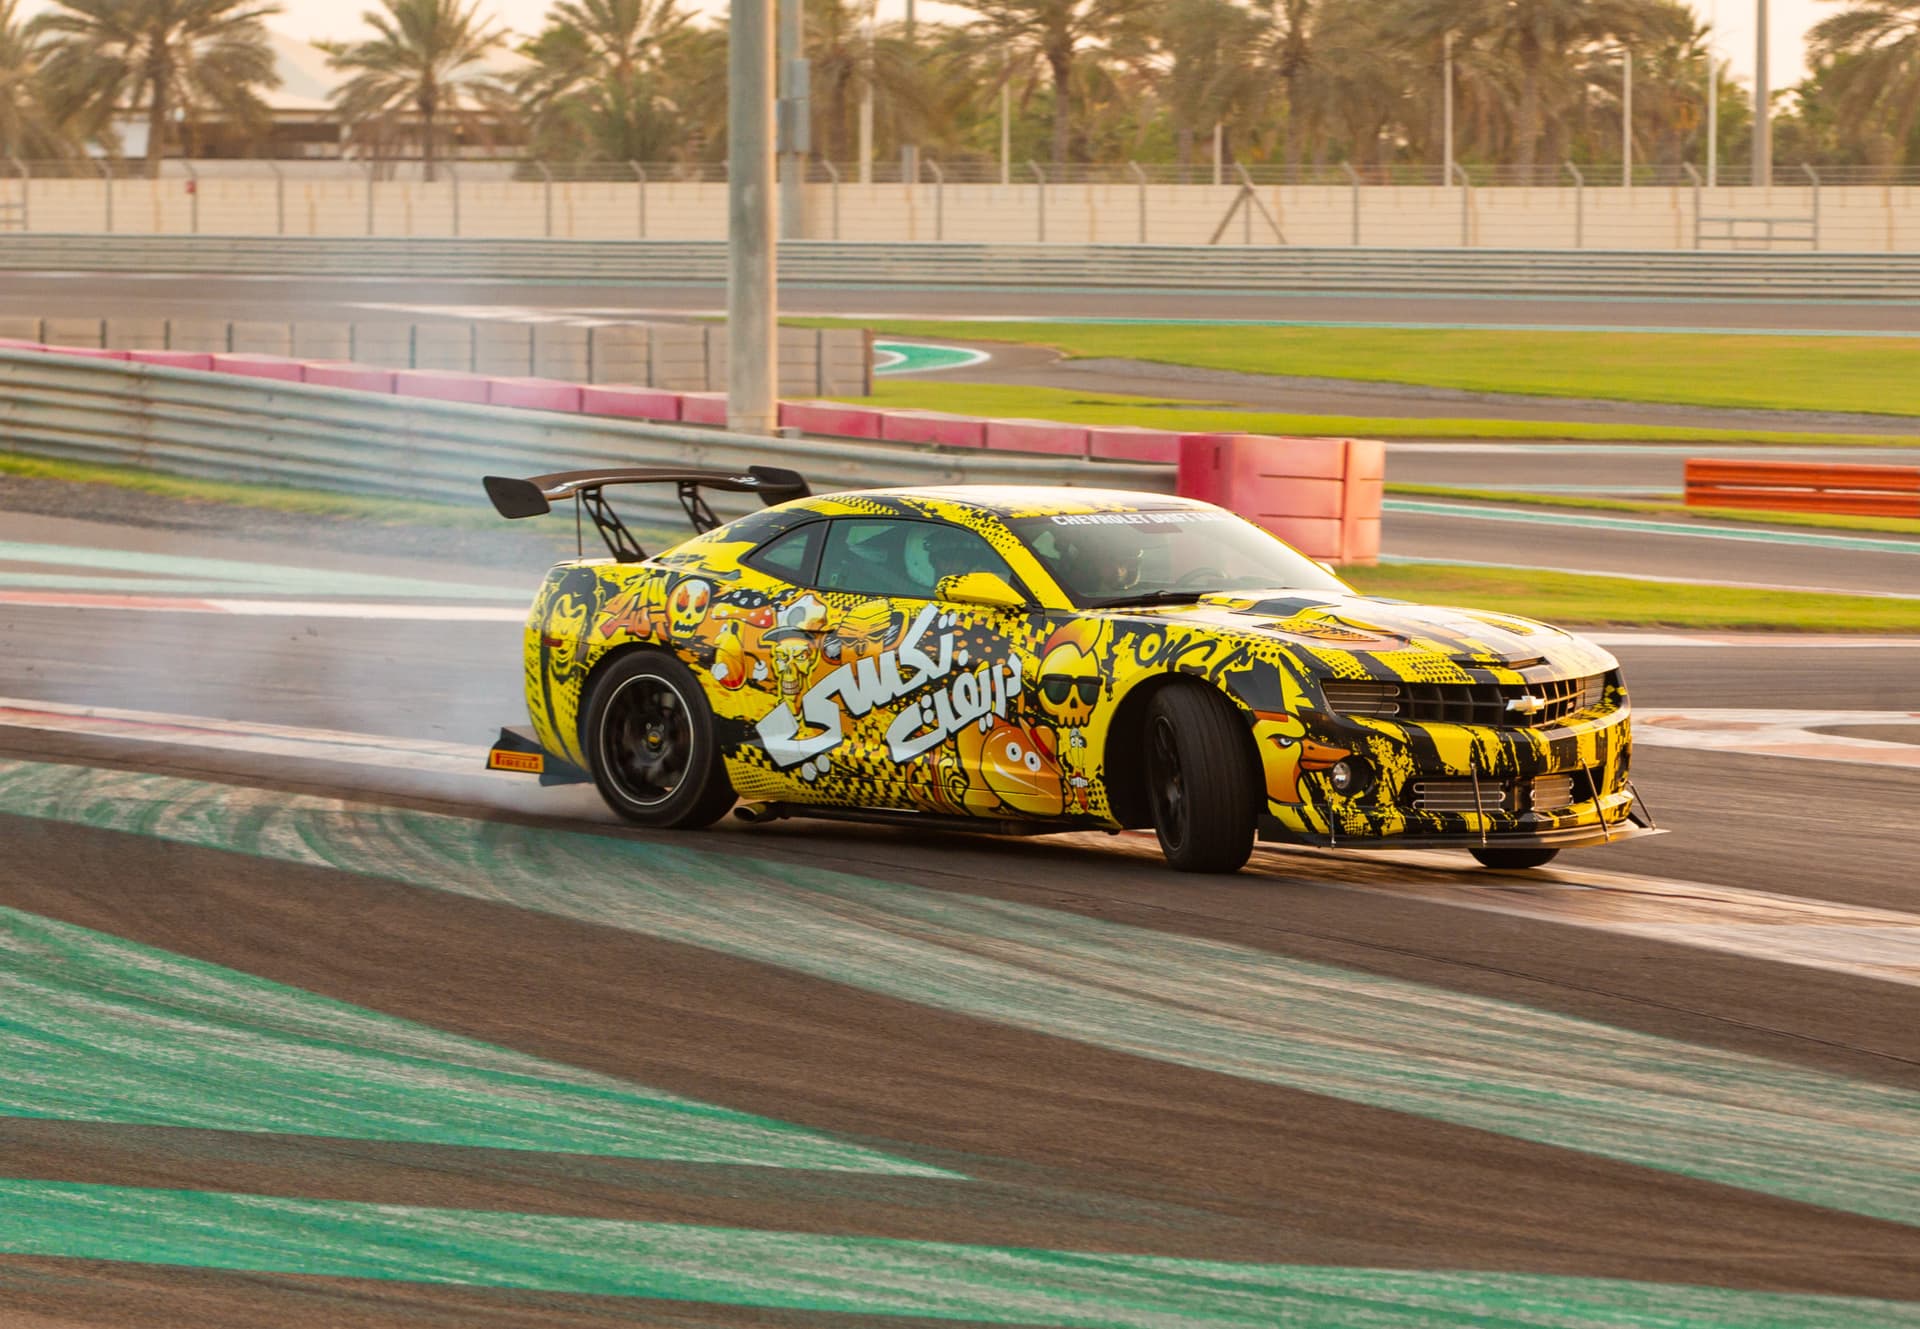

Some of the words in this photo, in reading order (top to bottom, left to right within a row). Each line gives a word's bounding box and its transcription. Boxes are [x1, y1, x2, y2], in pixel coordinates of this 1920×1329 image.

[1050, 513, 1150, 526] CHEVROLET
[755, 603, 957, 782] تكسي
[885, 649, 1022, 763] دريفت
[495, 752, 539, 769] PIRELLI
